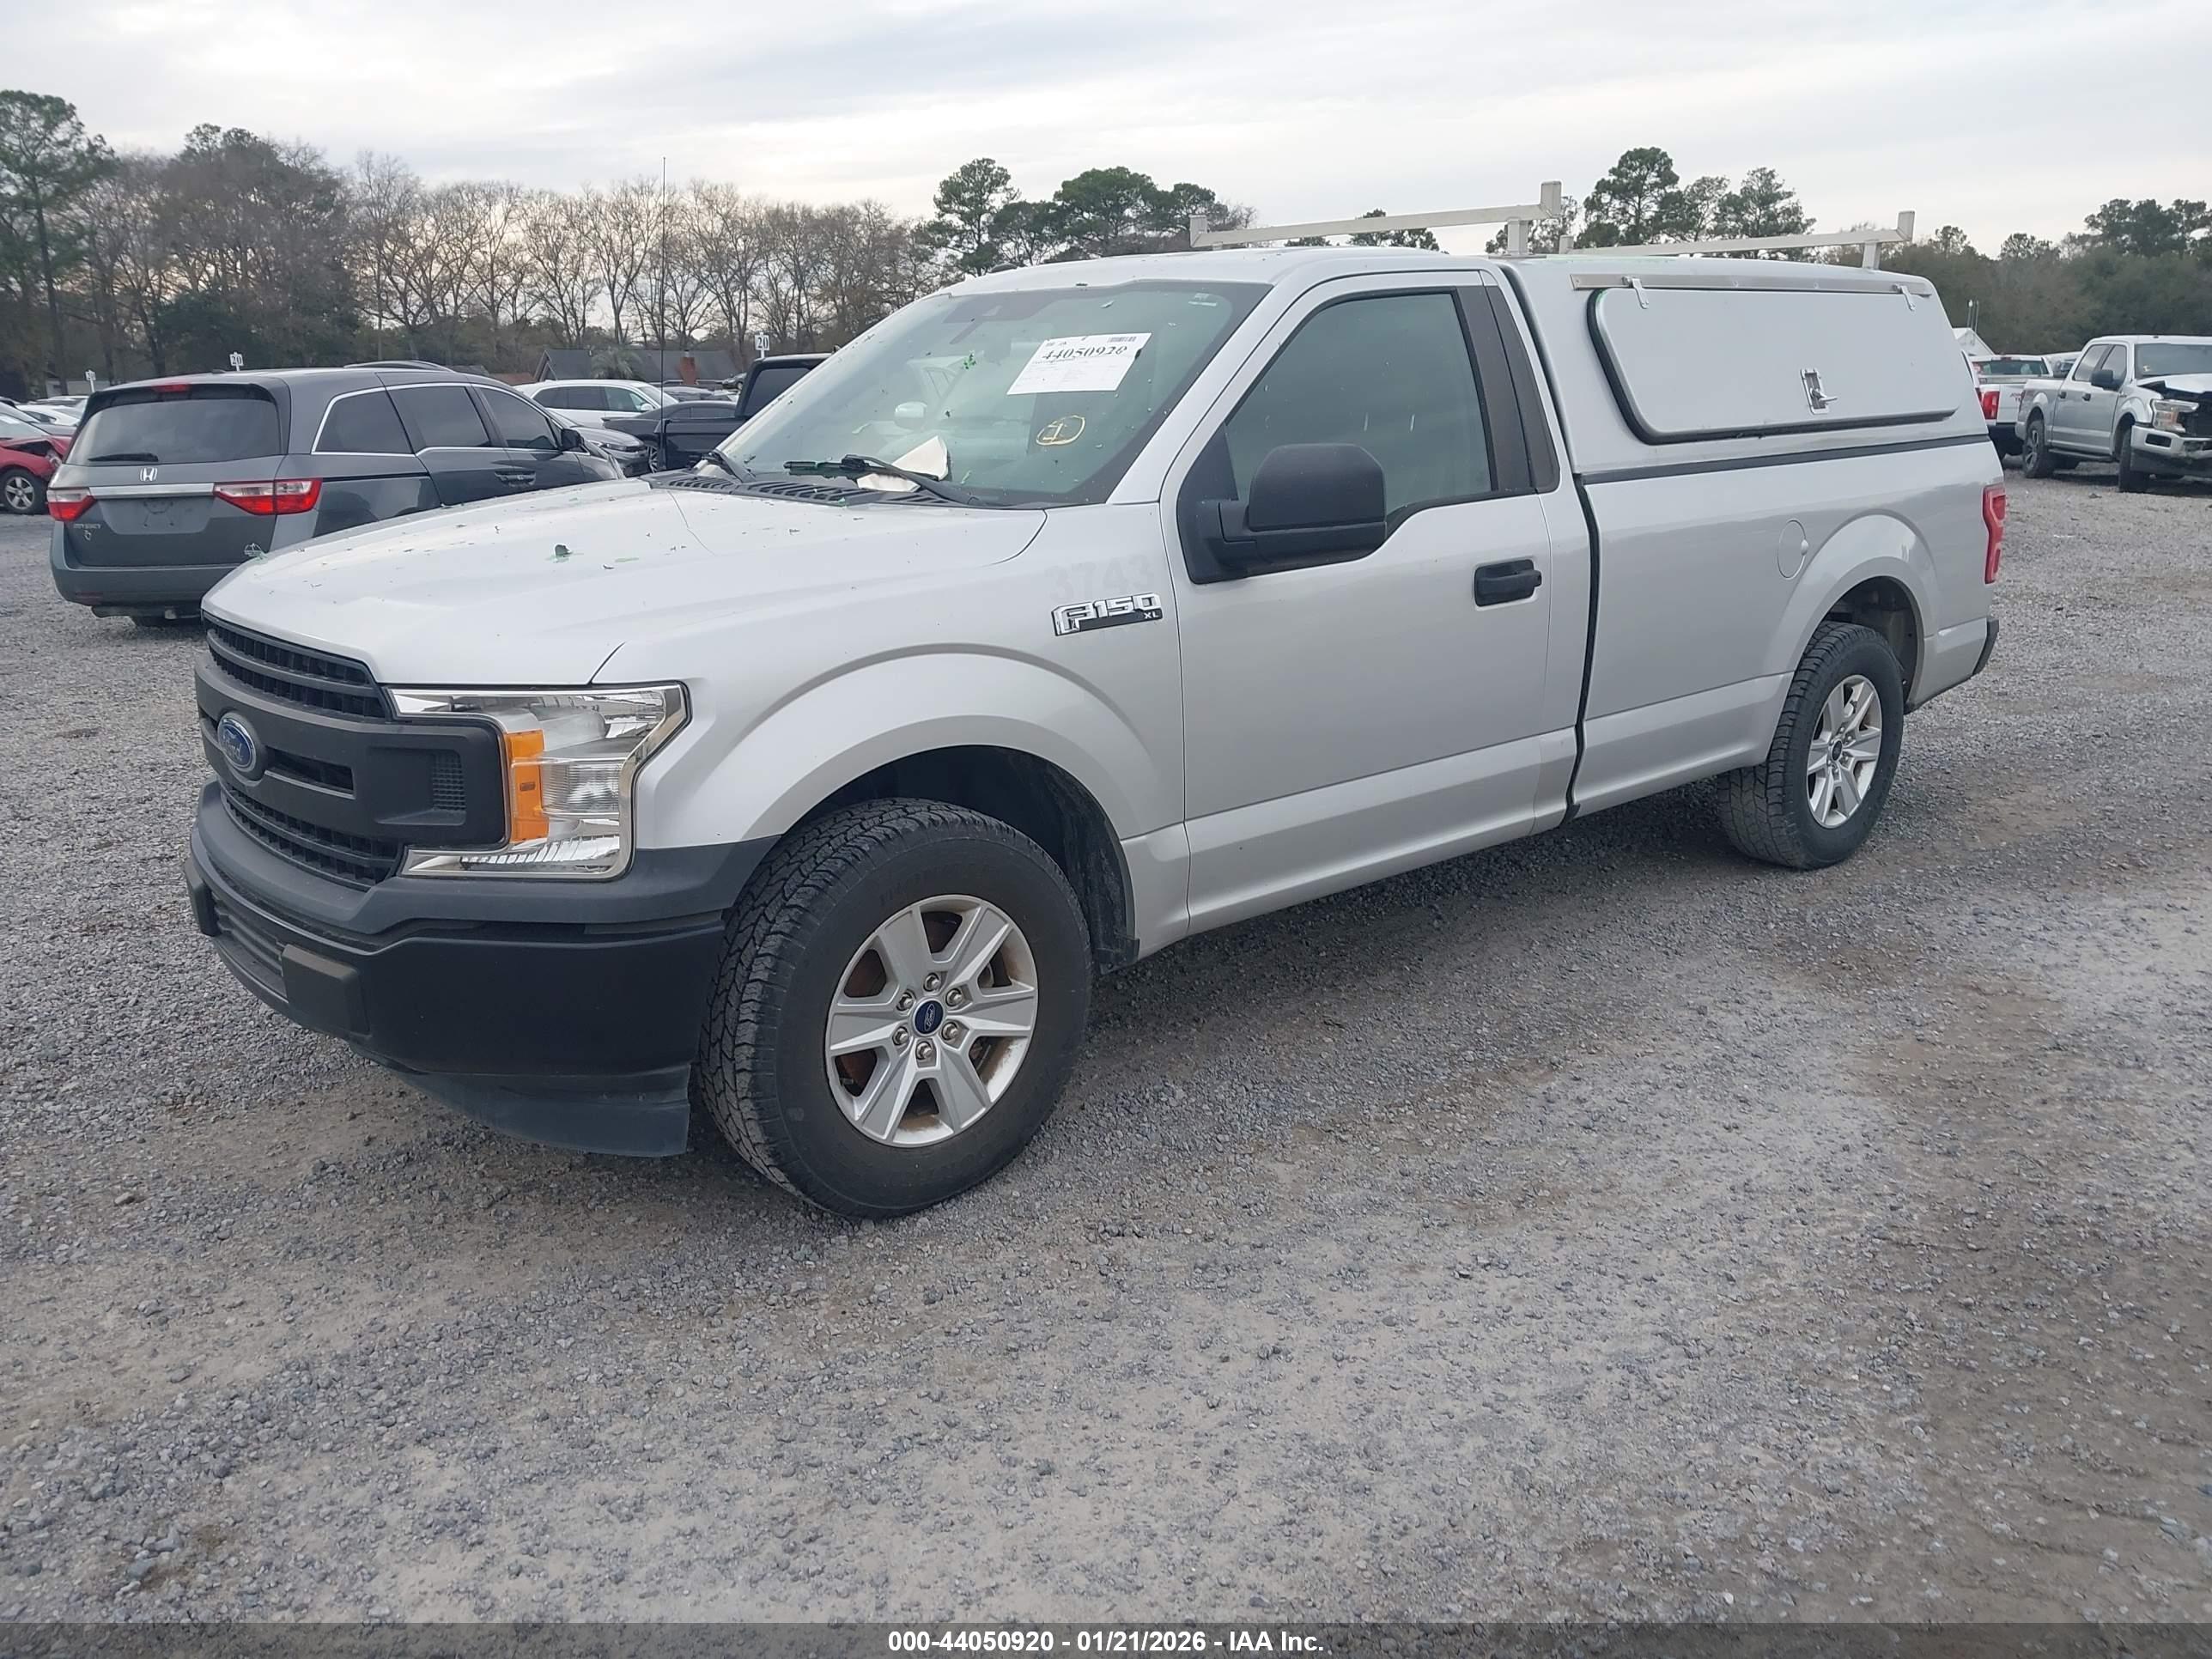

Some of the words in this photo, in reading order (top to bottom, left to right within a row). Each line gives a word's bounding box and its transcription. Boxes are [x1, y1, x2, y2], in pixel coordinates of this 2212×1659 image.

[758, 337, 769, 349] 20
[1052, 592, 1162, 635] F150
[1144, 611, 1159, 620] XL
